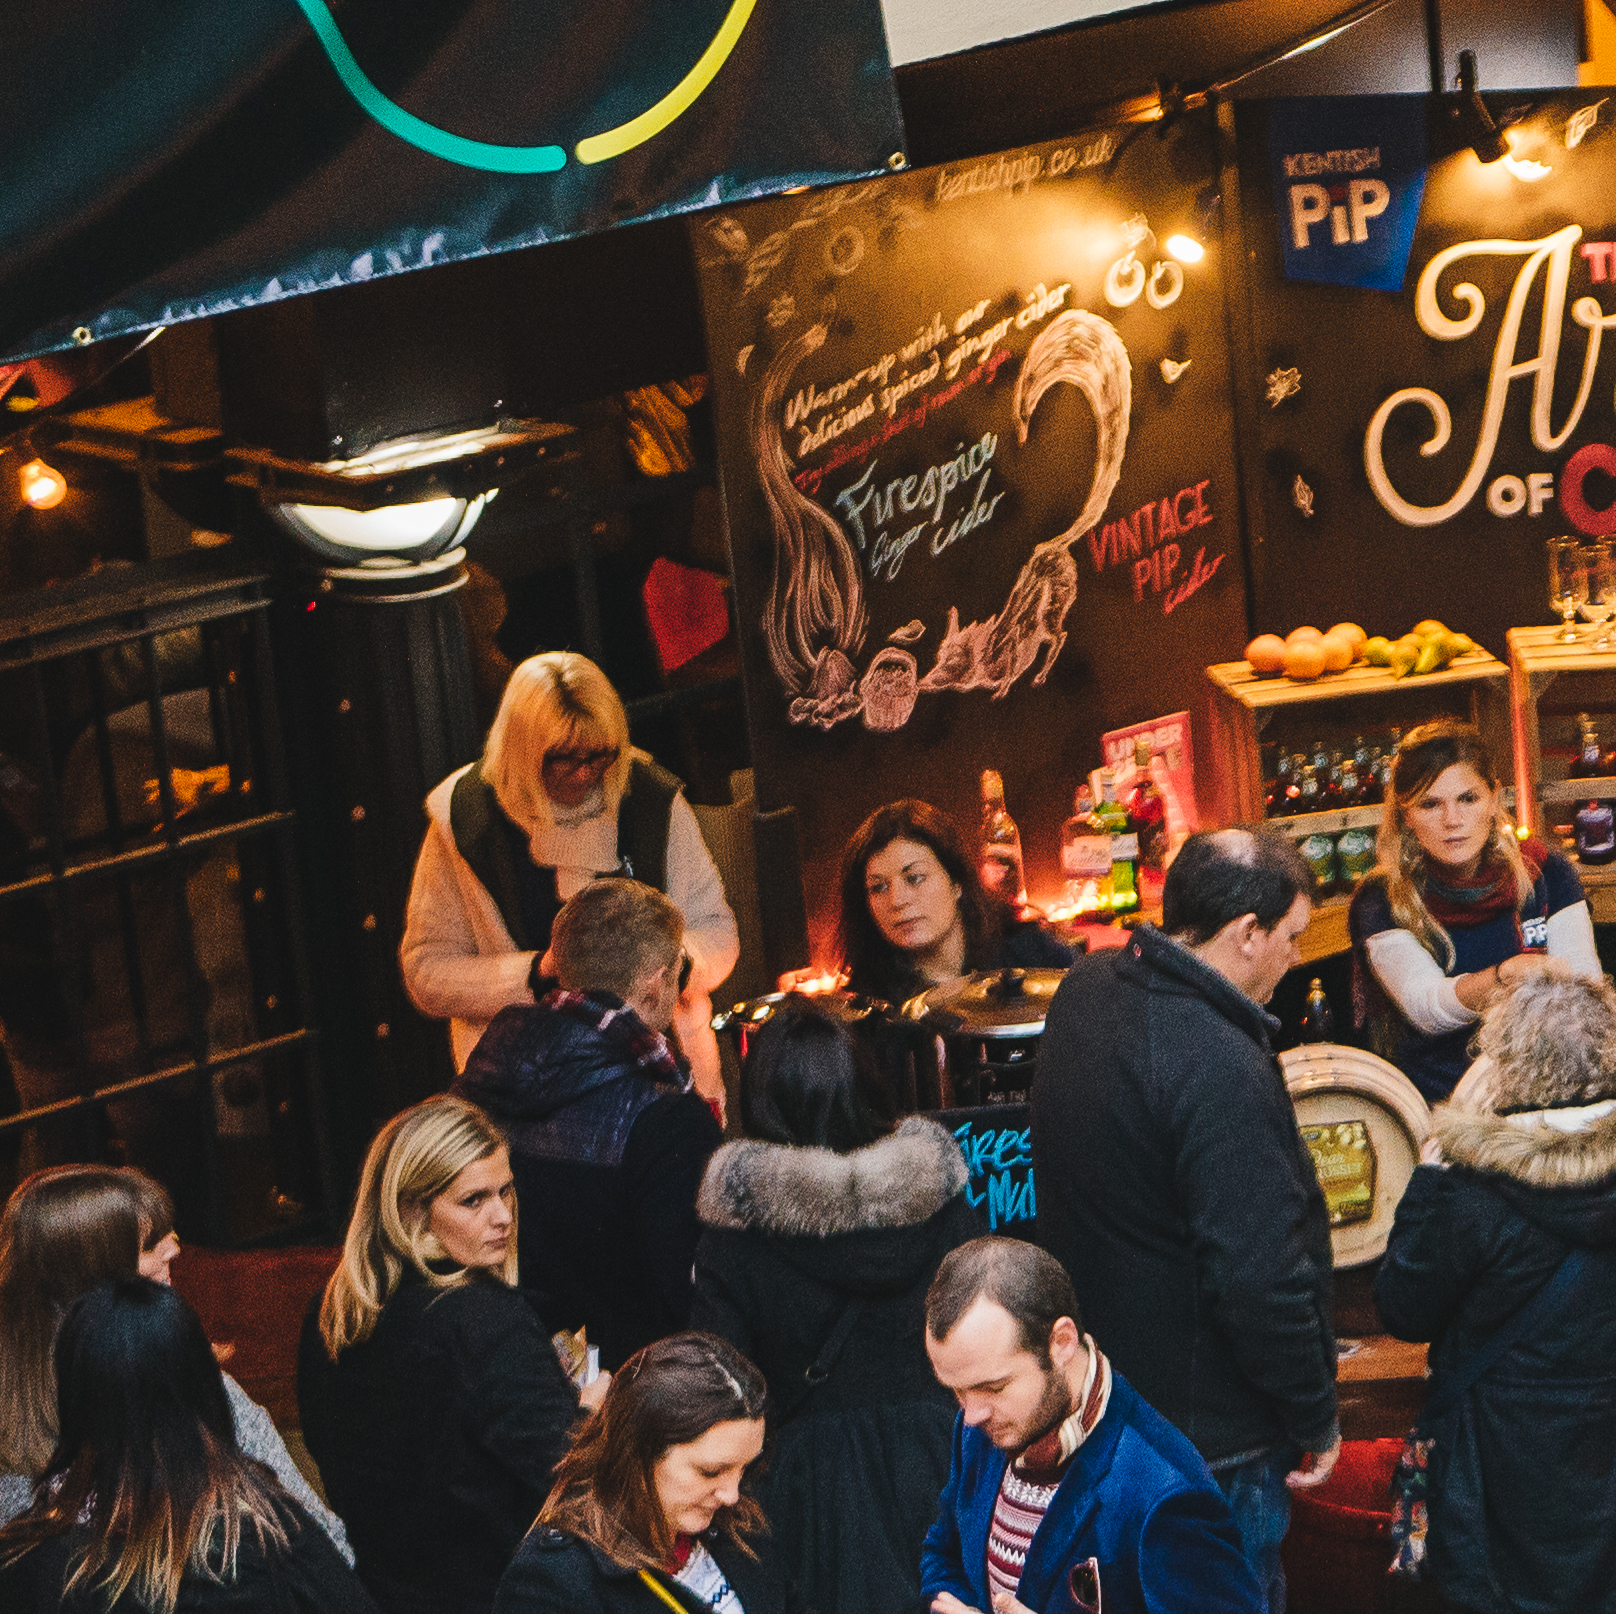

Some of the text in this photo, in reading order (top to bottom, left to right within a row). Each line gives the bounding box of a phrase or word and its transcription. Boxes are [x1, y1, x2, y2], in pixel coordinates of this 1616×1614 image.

[1281, 145, 1381, 178] KENTISH
[1288, 177, 1392, 250] PiP
[1014, 283, 1071, 330] cider
[835, 431, 998, 549] Firespice
[1485, 473, 1554, 517] OF
[1086, 479, 1215, 572] VINTAGE
[1132, 543, 1182, 604] PIP
